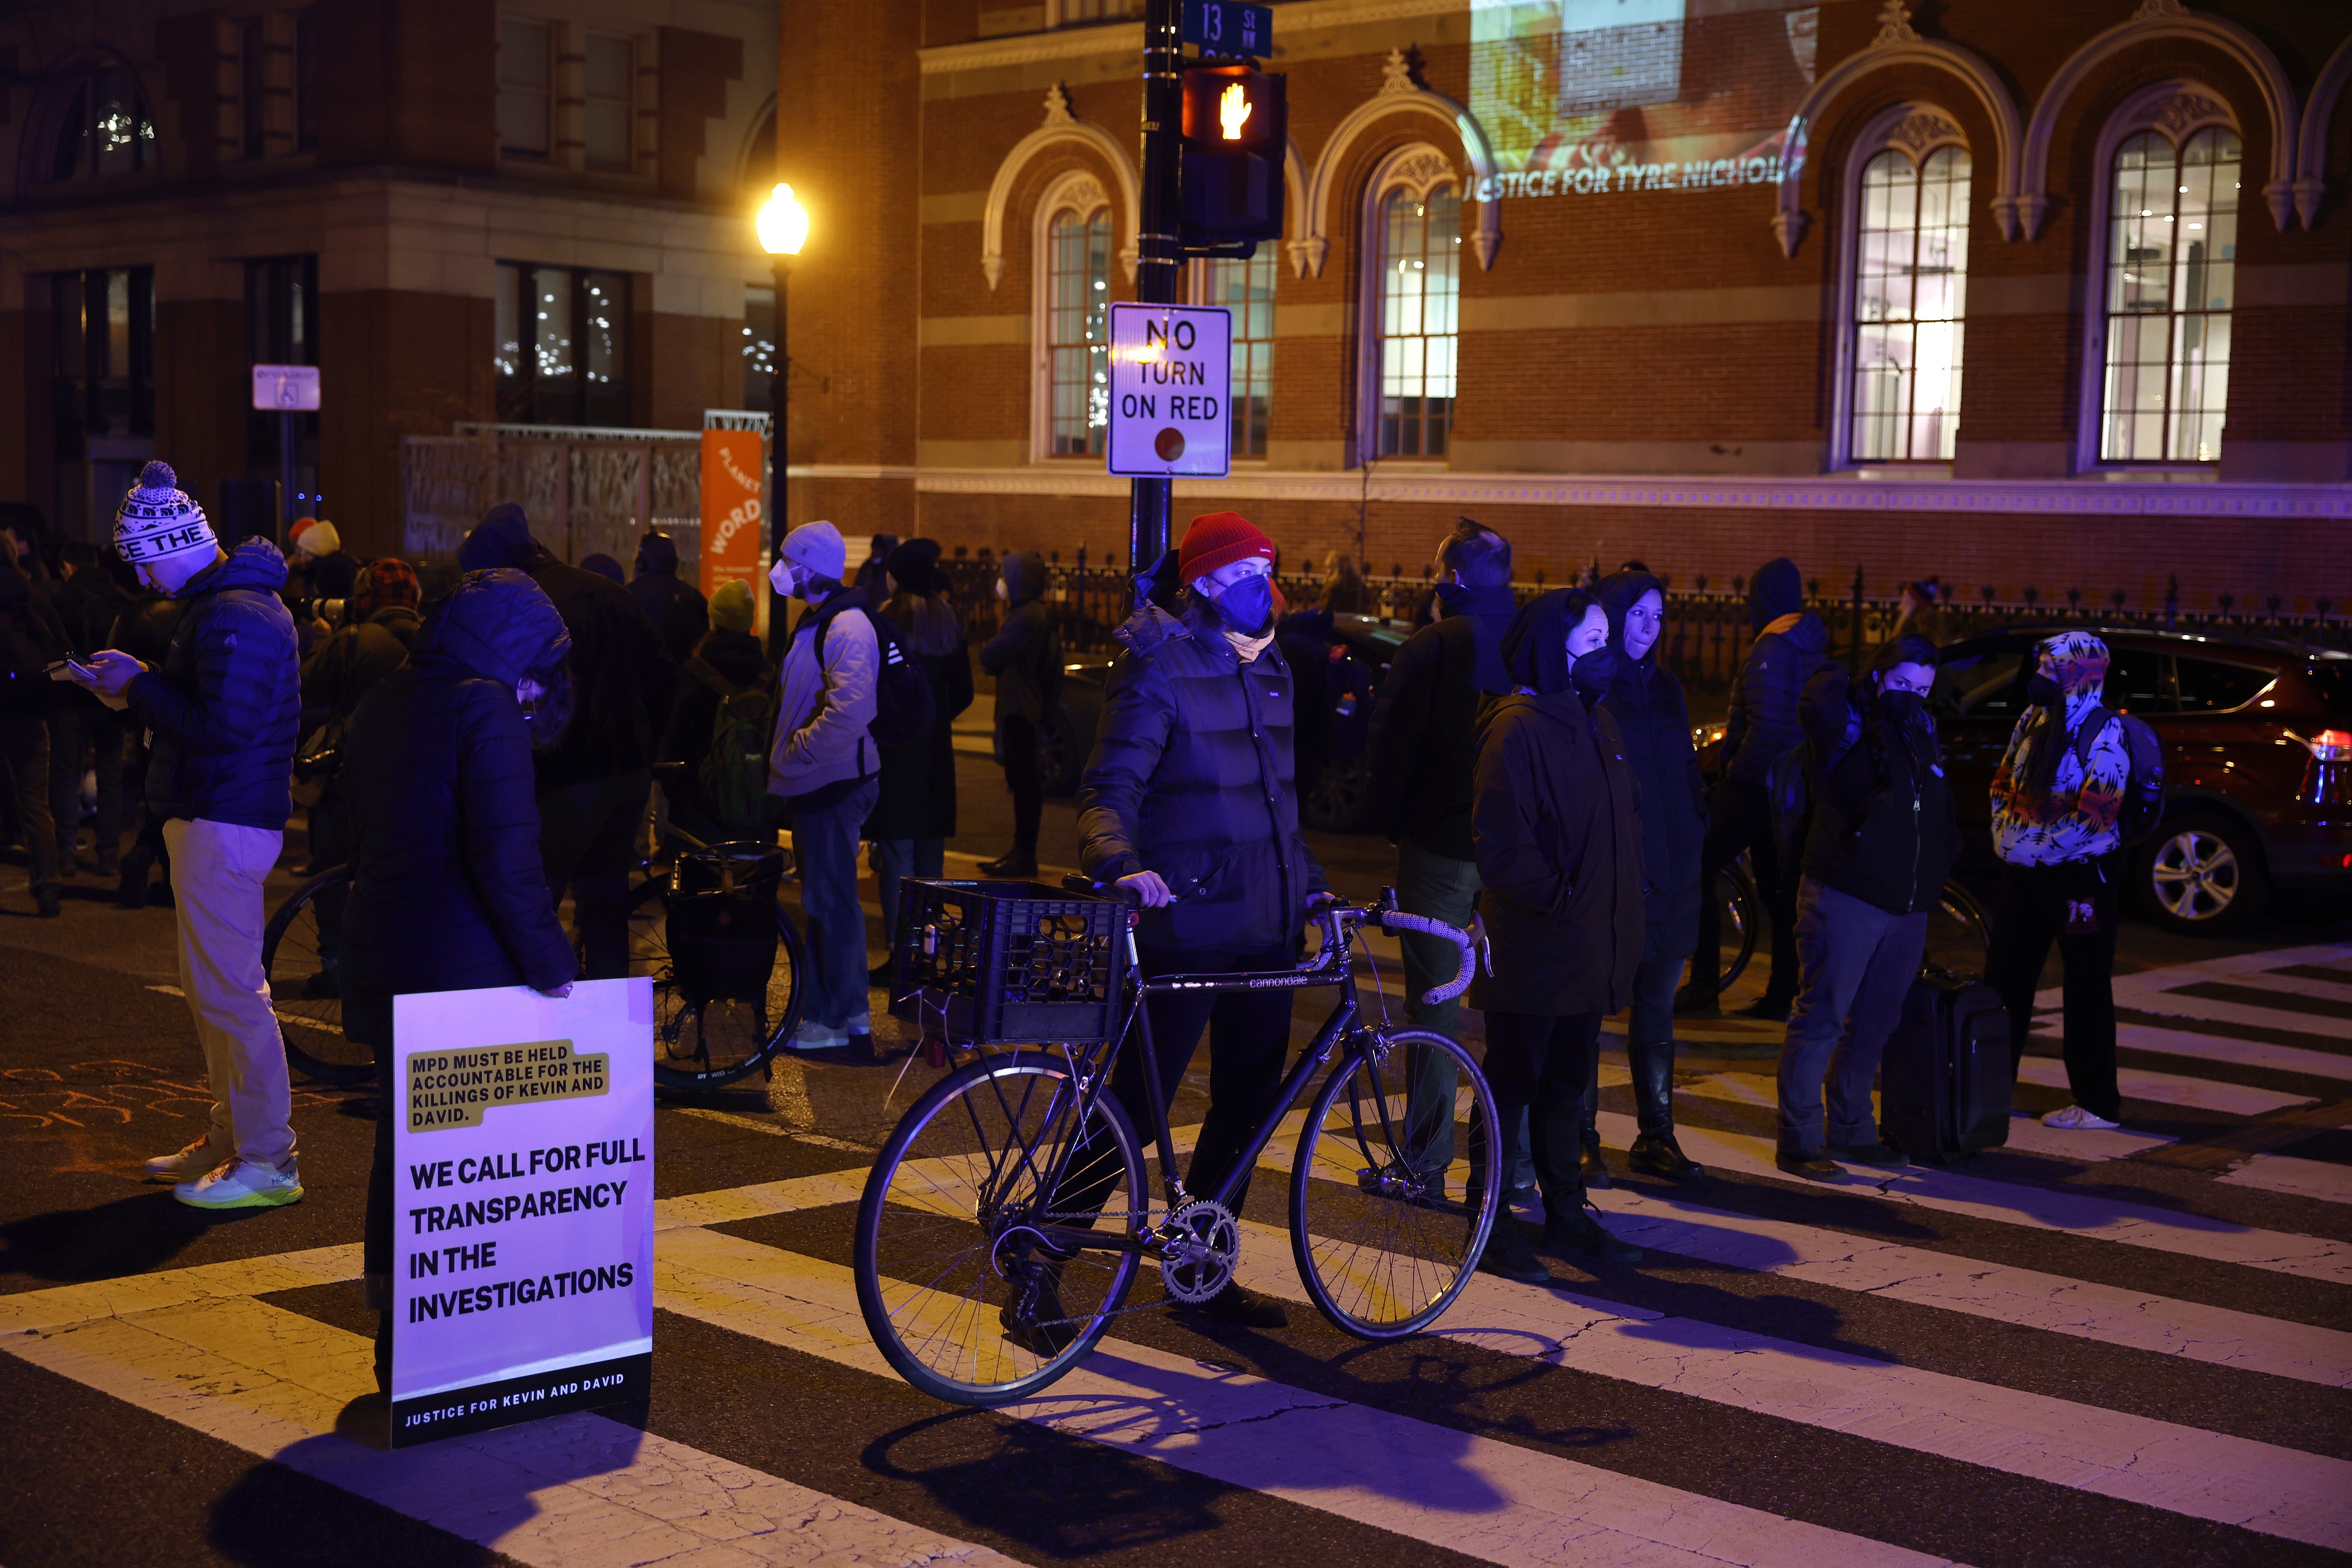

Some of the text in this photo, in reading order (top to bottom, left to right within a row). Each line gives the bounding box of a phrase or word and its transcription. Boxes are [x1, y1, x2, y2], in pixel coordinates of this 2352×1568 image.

[1202, 2, 1256, 41] 13 St
[1561, 166, 1610, 195] FOR
[1616, 162, 1680, 191] TYRE
[1147, 319, 1196, 351] NO
[1138, 360, 1204, 385] TURN
[1122, 393, 1218, 420] ON RED
[718, 446, 761, 494] PLANET
[147, 526, 203, 551] THE
[709, 498, 762, 555] WORD
[1250, 975, 1308, 988] cannondale
[413, 1046, 568, 1073] MPD MUST BE HELD
[413, 1060, 602, 1091] ACCOUNTABLE FOR THE
[710, 1070, 726, 1078] WISS
[413, 1076, 604, 1109] KILLINGS OF KEVIN AND
[413, 1108, 469, 1126] DAVID.
[272, 1171, 294, 1186] HOKA
[410, 1138, 645, 1190] WE CALL FOR FULL
[410, 1180, 628, 1234] TRANSPARENCY
[410, 1241, 496, 1279] IN THE
[410, 1262, 633, 1323] INVESTIGATIONS
[406, 1373, 624, 1427] JUSTICE FOR KEVIN AND DAVID
